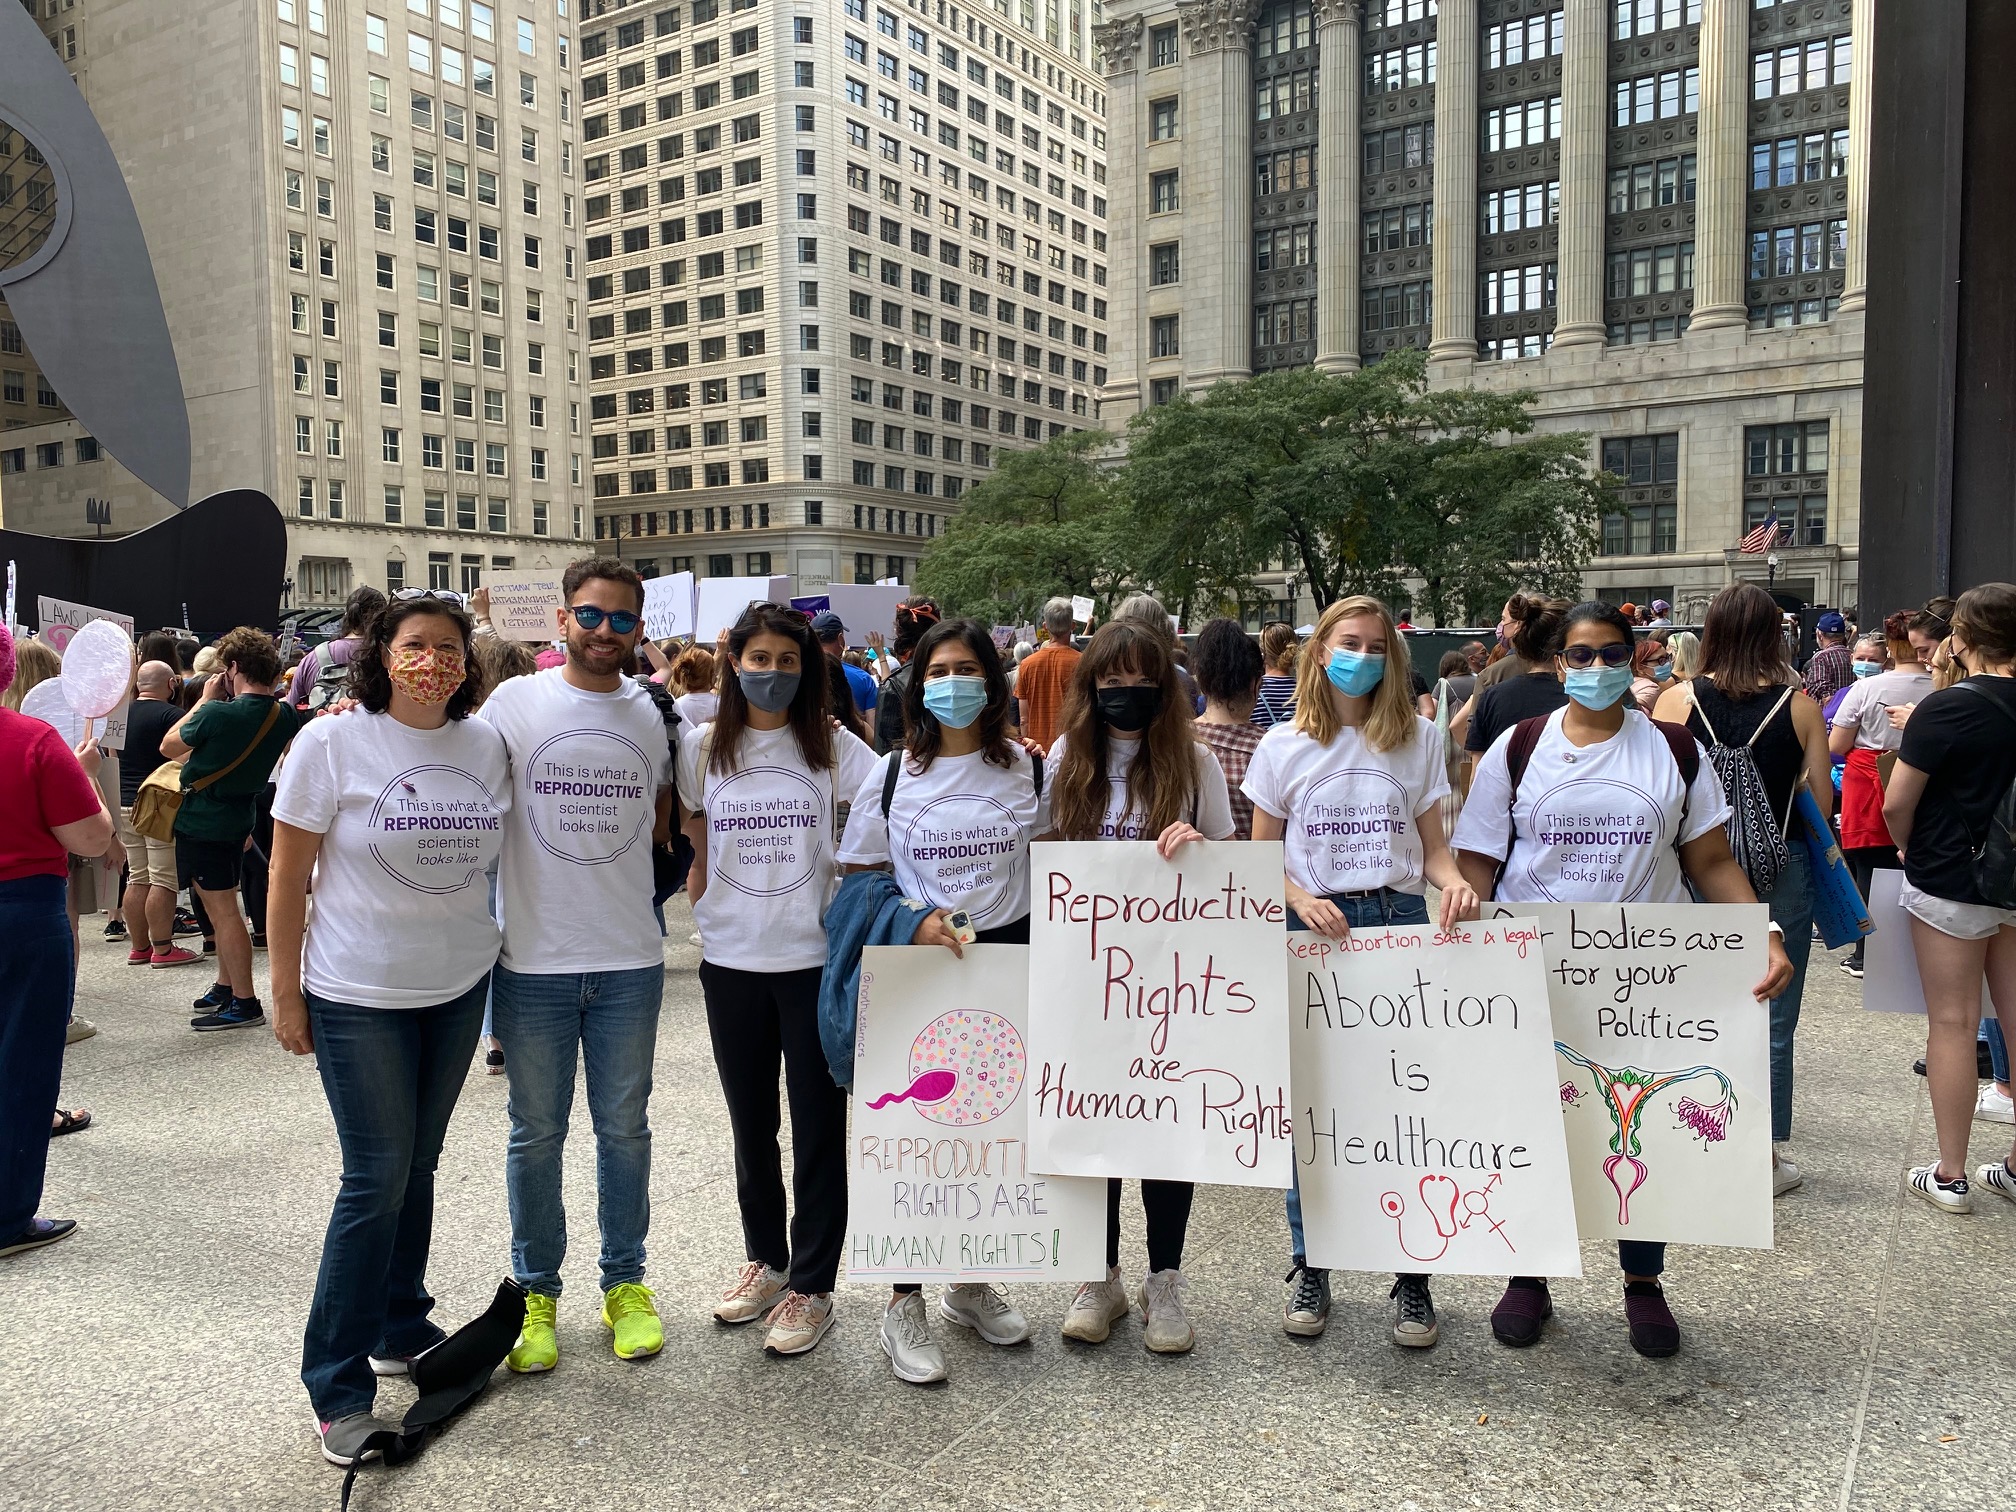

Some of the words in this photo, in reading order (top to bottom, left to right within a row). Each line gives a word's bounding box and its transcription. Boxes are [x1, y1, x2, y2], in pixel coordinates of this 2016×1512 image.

[41, 601, 81, 628] LAWS
[647, 611, 676, 629] MAD
[544, 762, 574, 777] This
[577, 764, 590, 778] is
[593, 766, 628, 780] what
[630, 771, 639, 781] a
[534, 780, 644, 799] REPRODUCTIVE
[397, 798, 429, 812] This
[431, 799, 444, 812] is
[446, 799, 480, 812] what
[481, 803, 489, 812] a
[559, 801, 618, 816] scientist
[720, 800, 747, 814] This
[750, 799, 762, 812] is
[765, 797, 799, 811] what
[802, 800, 810, 810] a
[1314, 804, 1341, 818] This
[1344, 804, 1356, 817] is
[1358, 802, 1392, 816] what
[1392, 805, 1400, 816] a
[384, 816, 500, 831] REPRODUCTIVE
[559, 818, 595, 833] looks
[597, 820, 620, 834] like
[713, 814, 817, 832] REPRODUCTIVE
[1544, 813, 1575, 827] This
[1578, 813, 1591, 827] is
[1594, 812, 1632, 827] what
[1636, 815, 1645, 826] a
[417, 836, 481, 849] scientist
[737, 834, 793, 848] scientist
[921, 829, 948, 843] This
[951, 828, 962, 841] is
[965, 825, 998, 840] what
[1000, 826, 1009, 836] a
[1539, 831, 1653, 846] REPRODUCTIVE
[912, 839, 1016, 860] REPRODUCTIVE
[1330, 839, 1389, 853] scientist
[416, 853, 454, 866] looks
[455, 852, 479, 864] like
[738, 851, 772, 865] looks
[774, 850, 796, 864] like
[1331, 857, 1367, 871] looks
[1369, 855, 1393, 869] like
[1560, 850, 1624, 865] scientist
[937, 860, 992, 878] scientist
[1560, 866, 1597, 883] looks
[1600, 869, 1625, 883] like
[939, 879, 973, 894] looks
[974, 875, 994, 888] like
[1048, 871, 1286, 961] Reproductive
[1571, 907, 1677, 952] bodies
[1684, 928, 1745, 952] are
[1339, 930, 1421, 953] abortion
[1432, 927, 1472, 947] safe
[1504, 925, 1540, 959] legal
[1552, 959, 1600, 986] for
[1615, 962, 1688, 1003] your
[1103, 946, 1256, 1056] Rights
[1306, 967, 1520, 1030] Abortion
[1597, 1005, 1720, 1042] Politics
[1129, 1056, 1185, 1083] are
[1390, 1048, 1430, 1093] is
[1035, 1062, 1179, 1124] Human
[1181, 1068, 1292, 1169] Rights
[1301, 1106, 1532, 1172] Healthcare
[860, 1135, 1027, 1180] REPRODUCTI
[893, 1181, 982, 1221] RIGHTS
[990, 1182, 1048, 1219] ARE
[852, 1233, 946, 1269] HUMAN
[960, 1229, 1060, 1267] RIGHTS!
